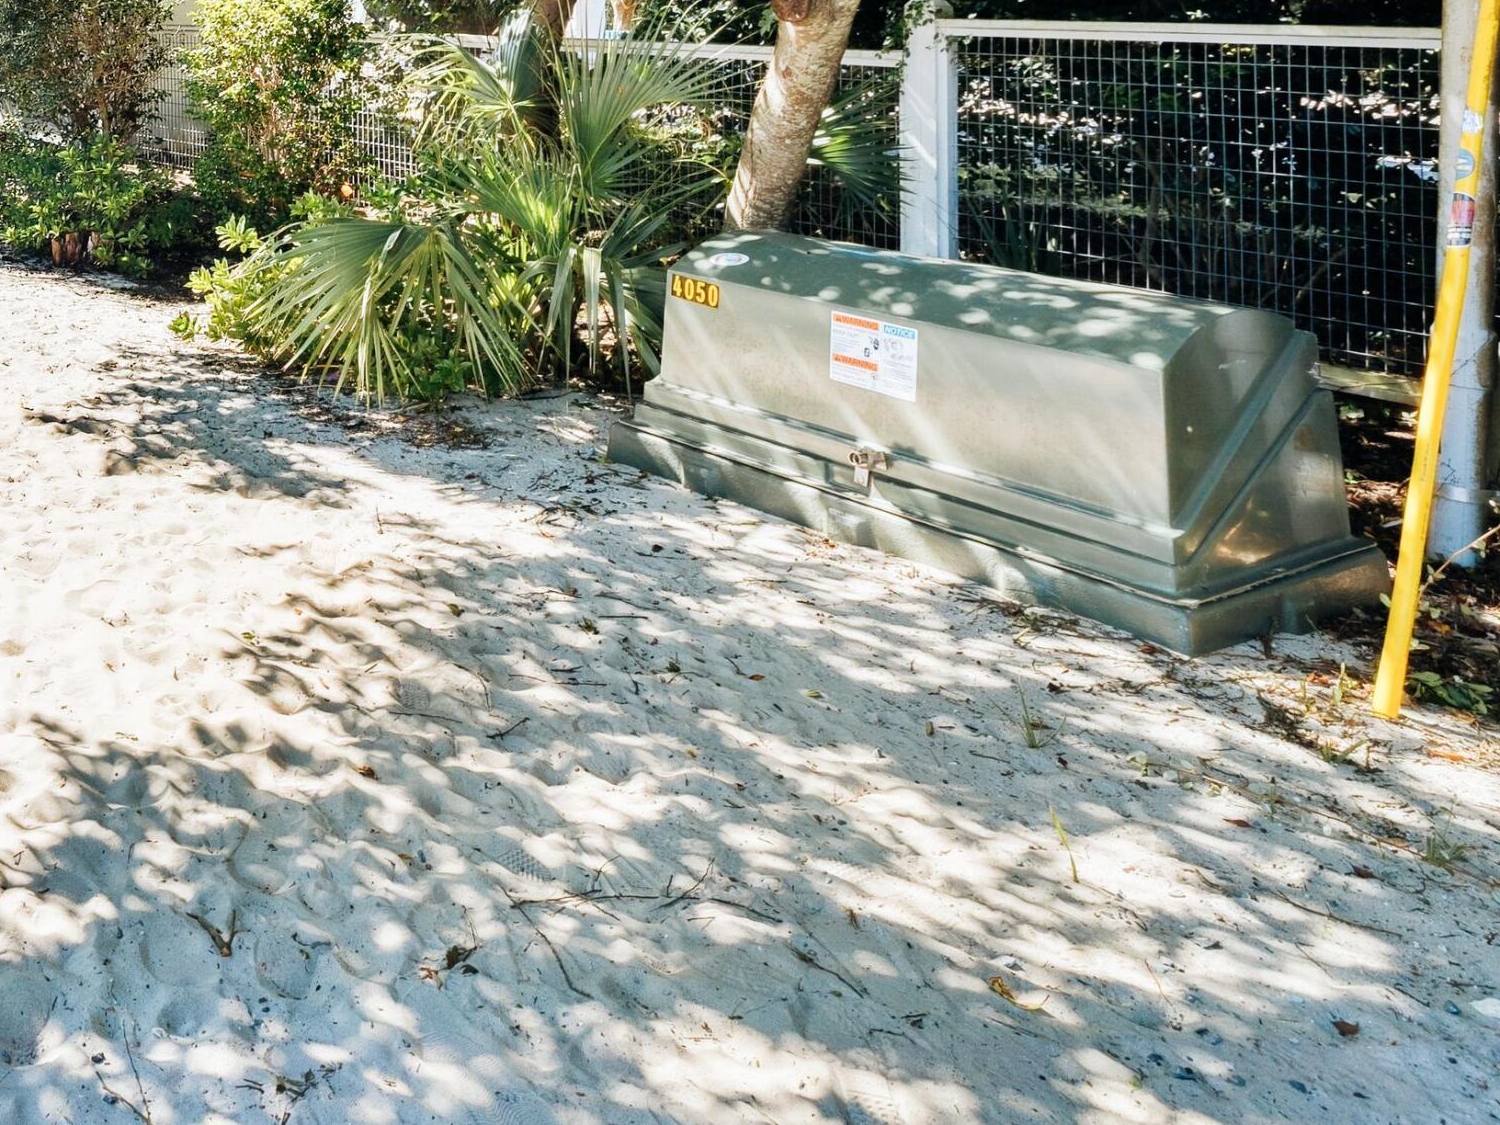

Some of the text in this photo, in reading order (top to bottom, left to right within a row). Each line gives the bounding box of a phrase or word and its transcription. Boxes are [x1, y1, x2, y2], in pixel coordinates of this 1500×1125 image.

[672, 275, 719, 309] 4050
[841, 316, 879, 331] WARNING
[883, 324, 916, 340] NOTICE
[840, 356, 878, 372] WARNING
